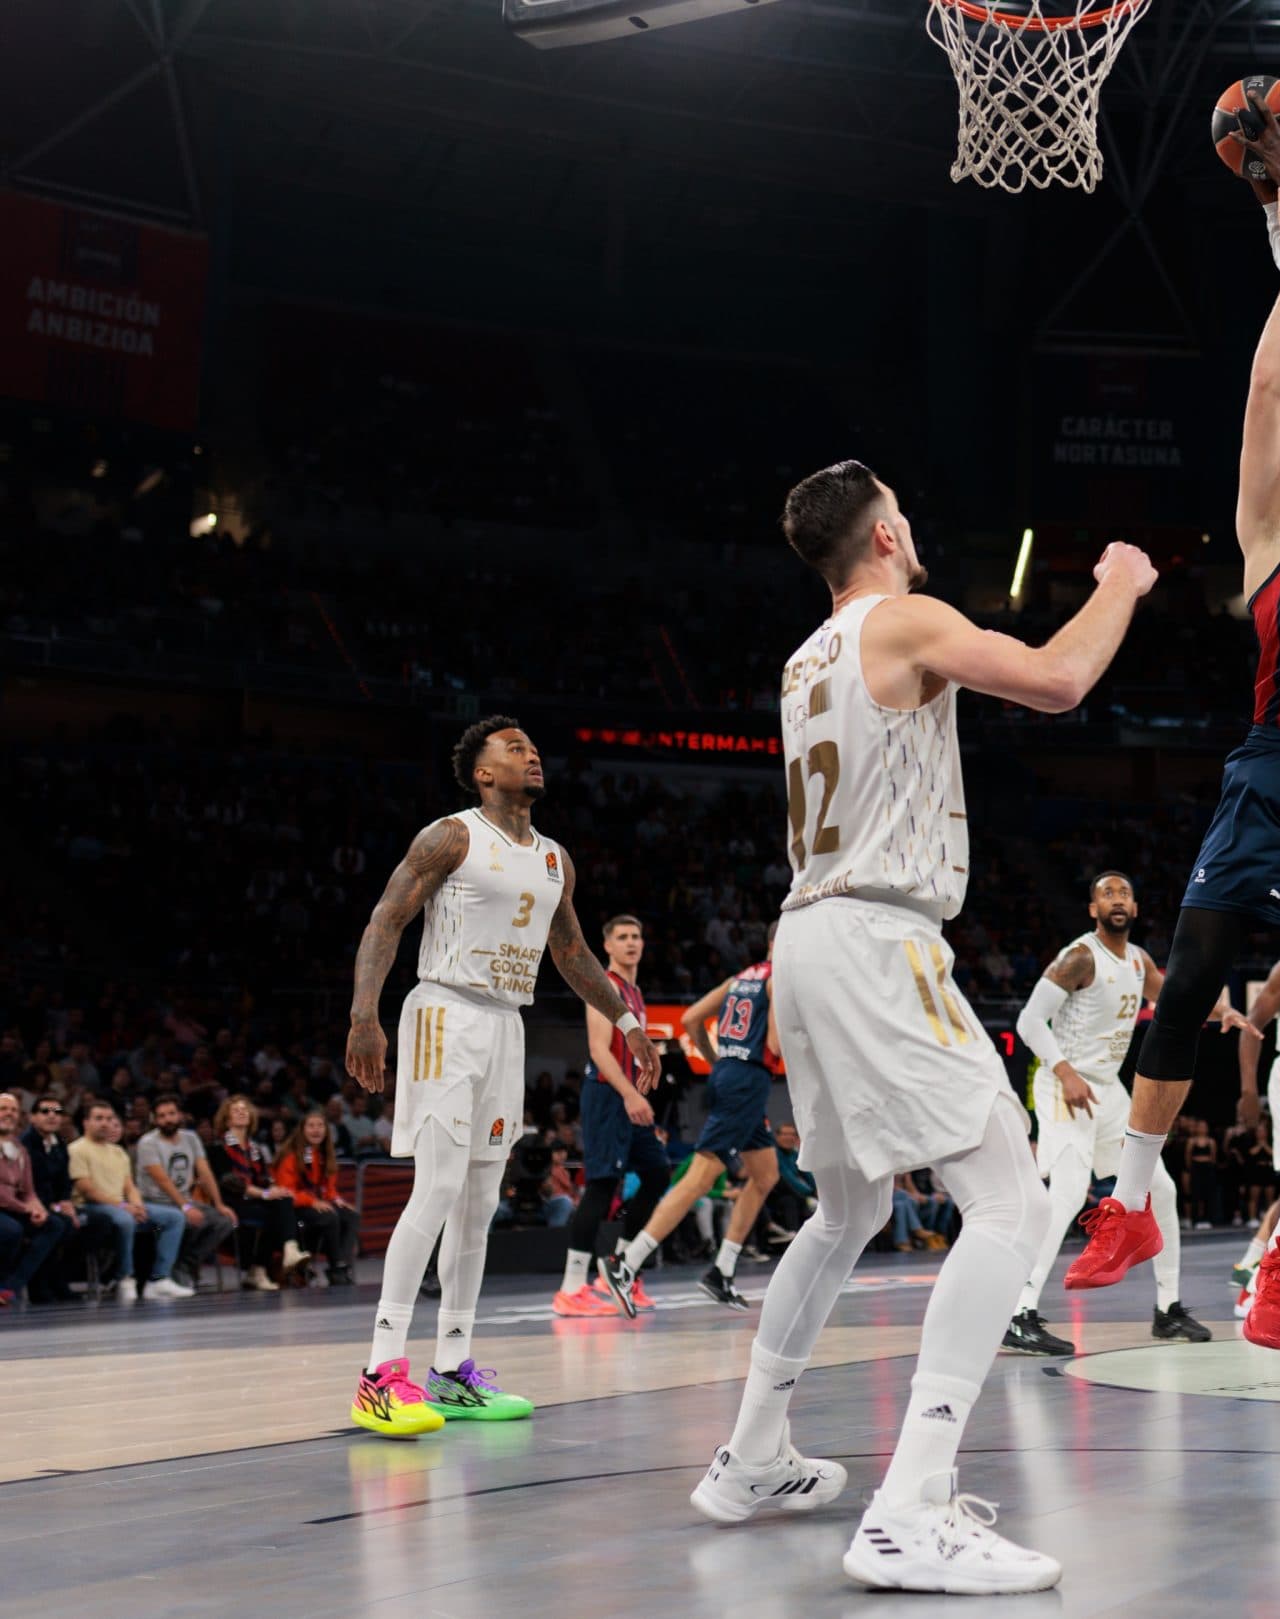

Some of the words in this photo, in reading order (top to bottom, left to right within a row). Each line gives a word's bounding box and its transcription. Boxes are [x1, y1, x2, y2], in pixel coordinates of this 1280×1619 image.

[27, 275, 161, 328] AMBICIÓN
[1061, 411, 1175, 439] CARÁCTER
[788, 739, 841, 873] 12
[512, 892, 535, 928] 3
[719, 996, 753, 1040] 13
[1116, 994, 1138, 1019] 23
